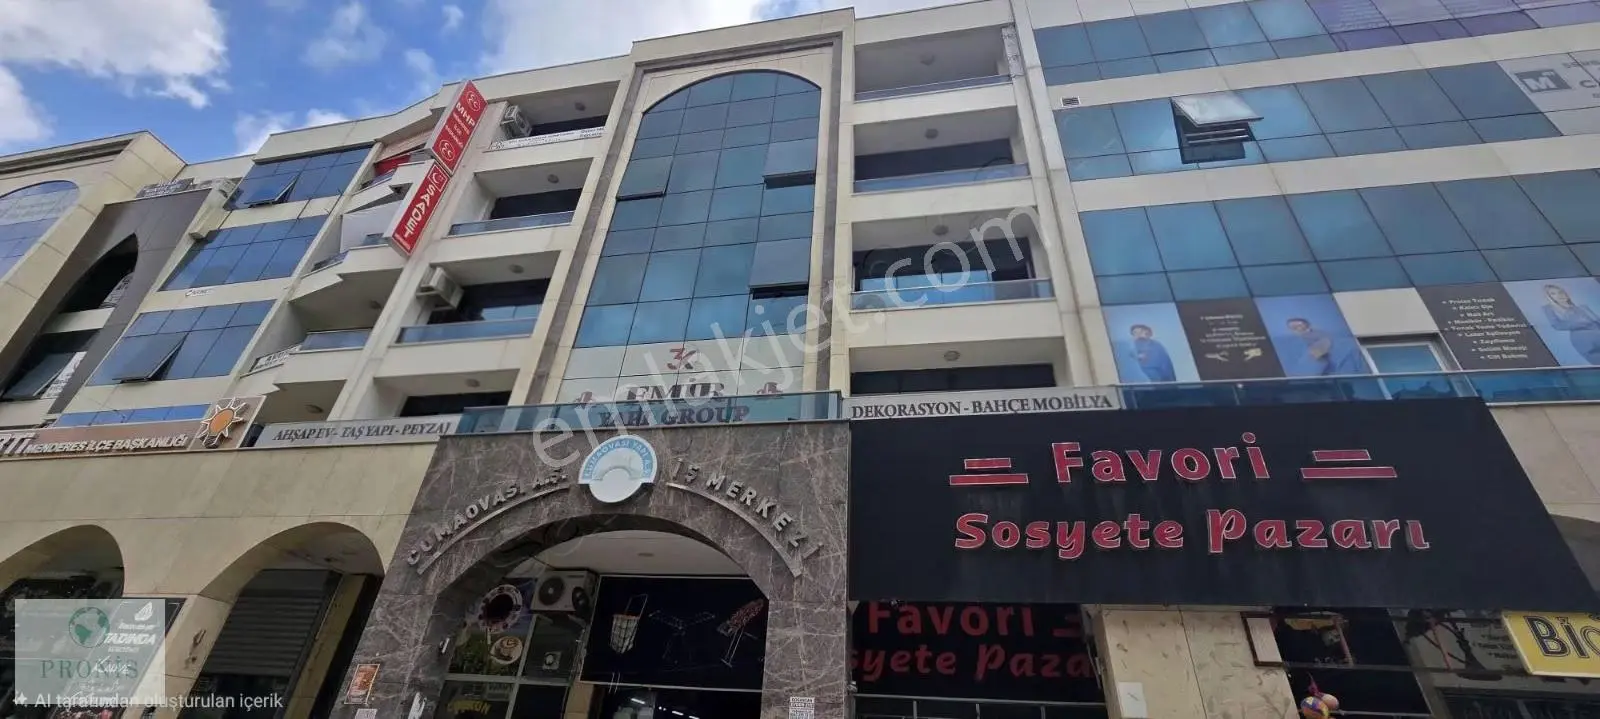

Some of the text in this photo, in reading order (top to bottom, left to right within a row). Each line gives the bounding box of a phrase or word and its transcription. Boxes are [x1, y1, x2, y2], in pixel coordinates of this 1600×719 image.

[455, 102, 476, 127] MHP
[404, 184, 436, 239] SAADET
[660, 405, 750, 426] GROUP
[850, 401, 961, 420] DEKORASYON
[972, 397, 1028, 415] BAHÇE
[1029, 392, 1113, 412] MOBİLYA
[272, 428, 317, 444] AHŞAP
[340, 426, 364, 440] TAŞ
[365, 425, 394, 438] YAPI
[401, 421, 452, 436] PEYZAJ
[1050, 432, 1271, 484] Favori
[672, 457, 825, 561] İŞ MERKEZİ
[954, 508, 1431, 560] Sosyete Pazarı
